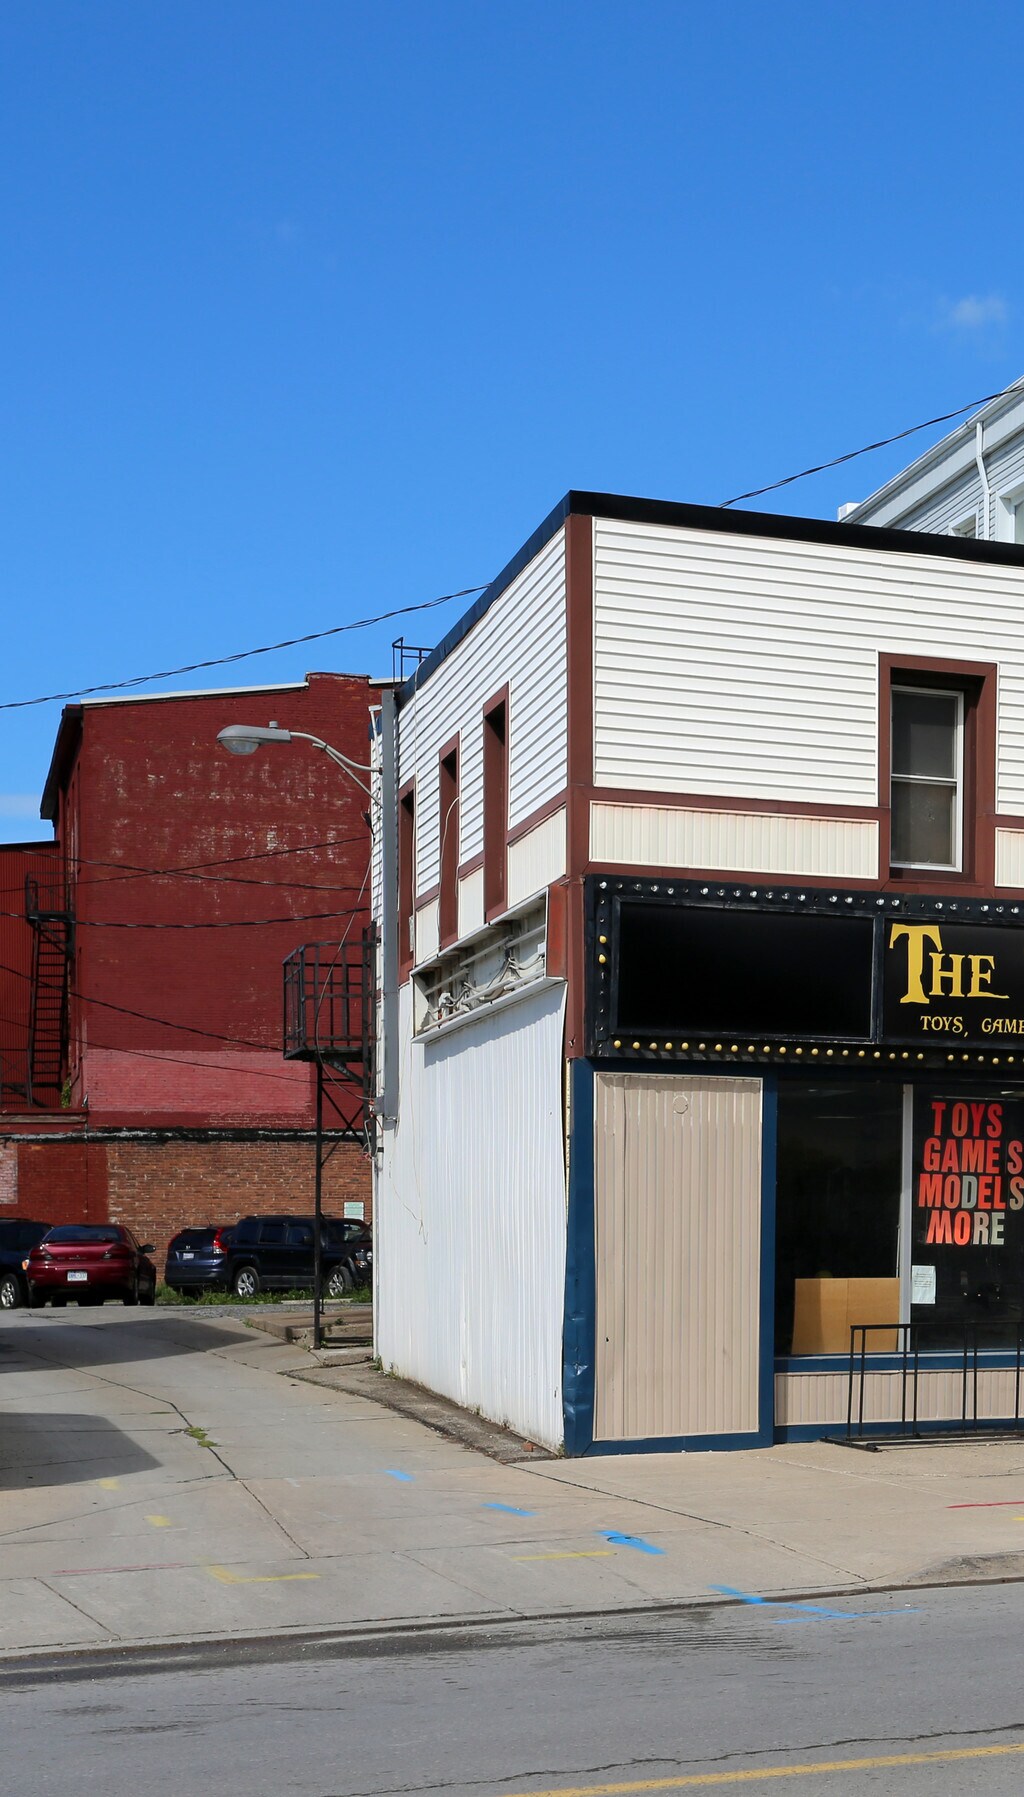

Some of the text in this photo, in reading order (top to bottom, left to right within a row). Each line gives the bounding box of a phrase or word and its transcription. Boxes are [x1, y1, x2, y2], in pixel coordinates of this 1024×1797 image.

[889, 923, 1009, 1005] THE
[920, 1015, 968, 1038] TOYS,
[931, 1102, 1003, 1138] TOYS
[923, 1137, 1024, 1175] GAMES
[926, 1209, 1006, 1246] MORE
